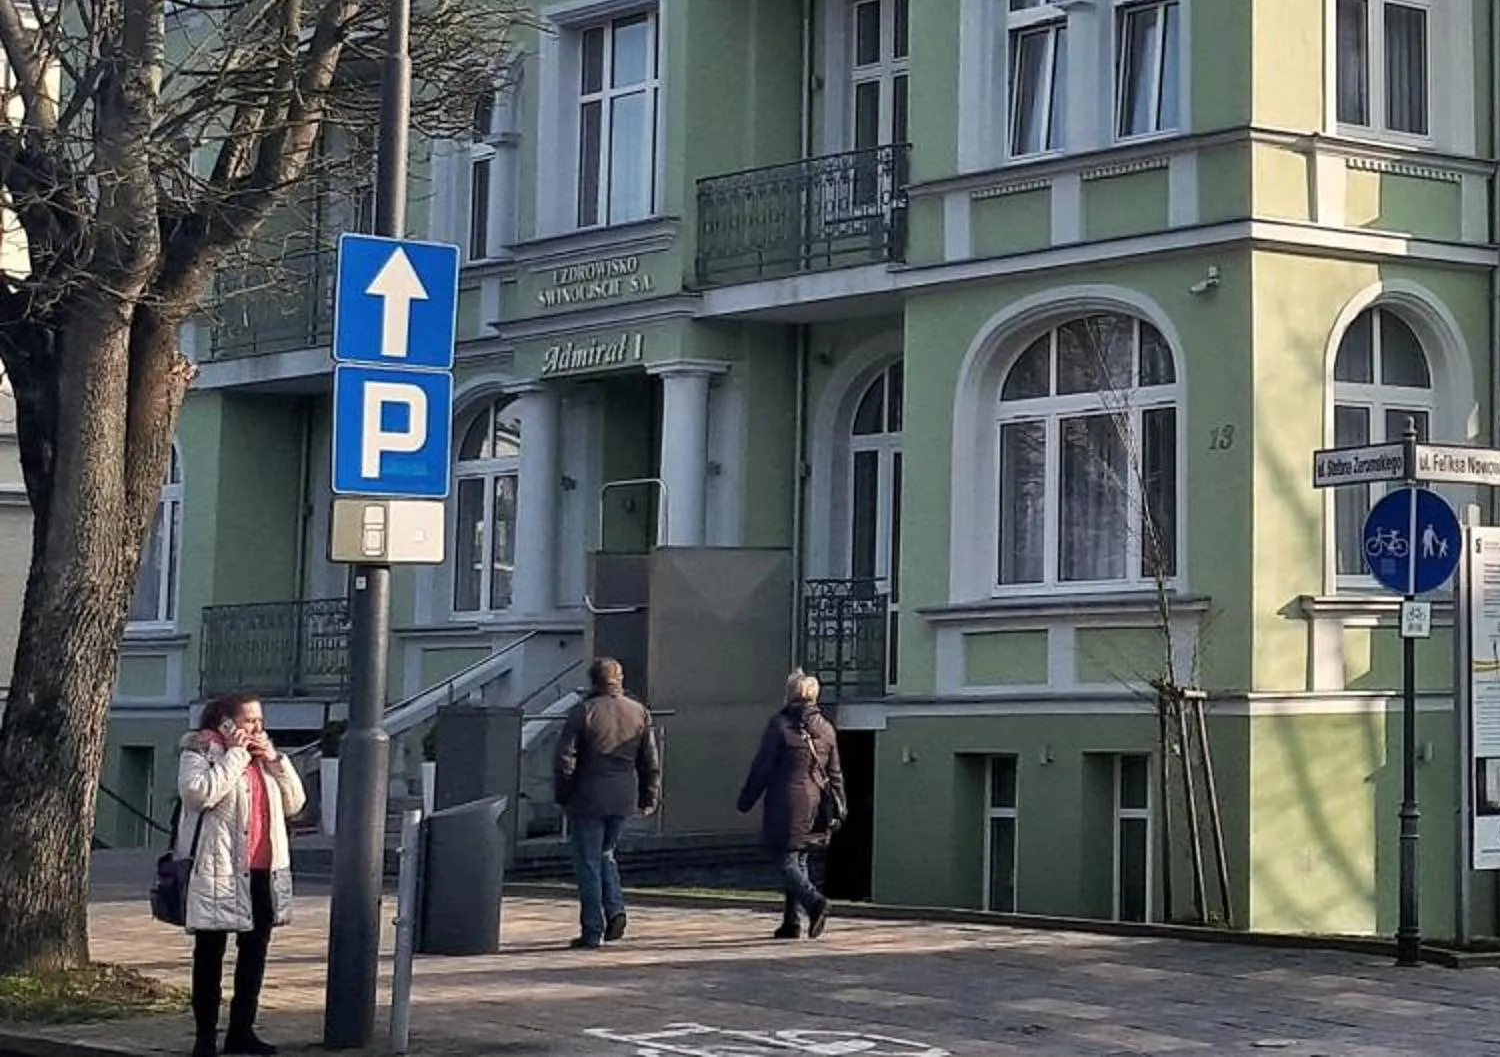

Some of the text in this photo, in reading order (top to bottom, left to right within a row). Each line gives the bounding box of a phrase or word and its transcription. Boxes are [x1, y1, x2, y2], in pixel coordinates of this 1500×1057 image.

[362, 380, 428, 479] P
[1208, 424, 1235, 451] 13
[1419, 452, 1431, 472] ul.
